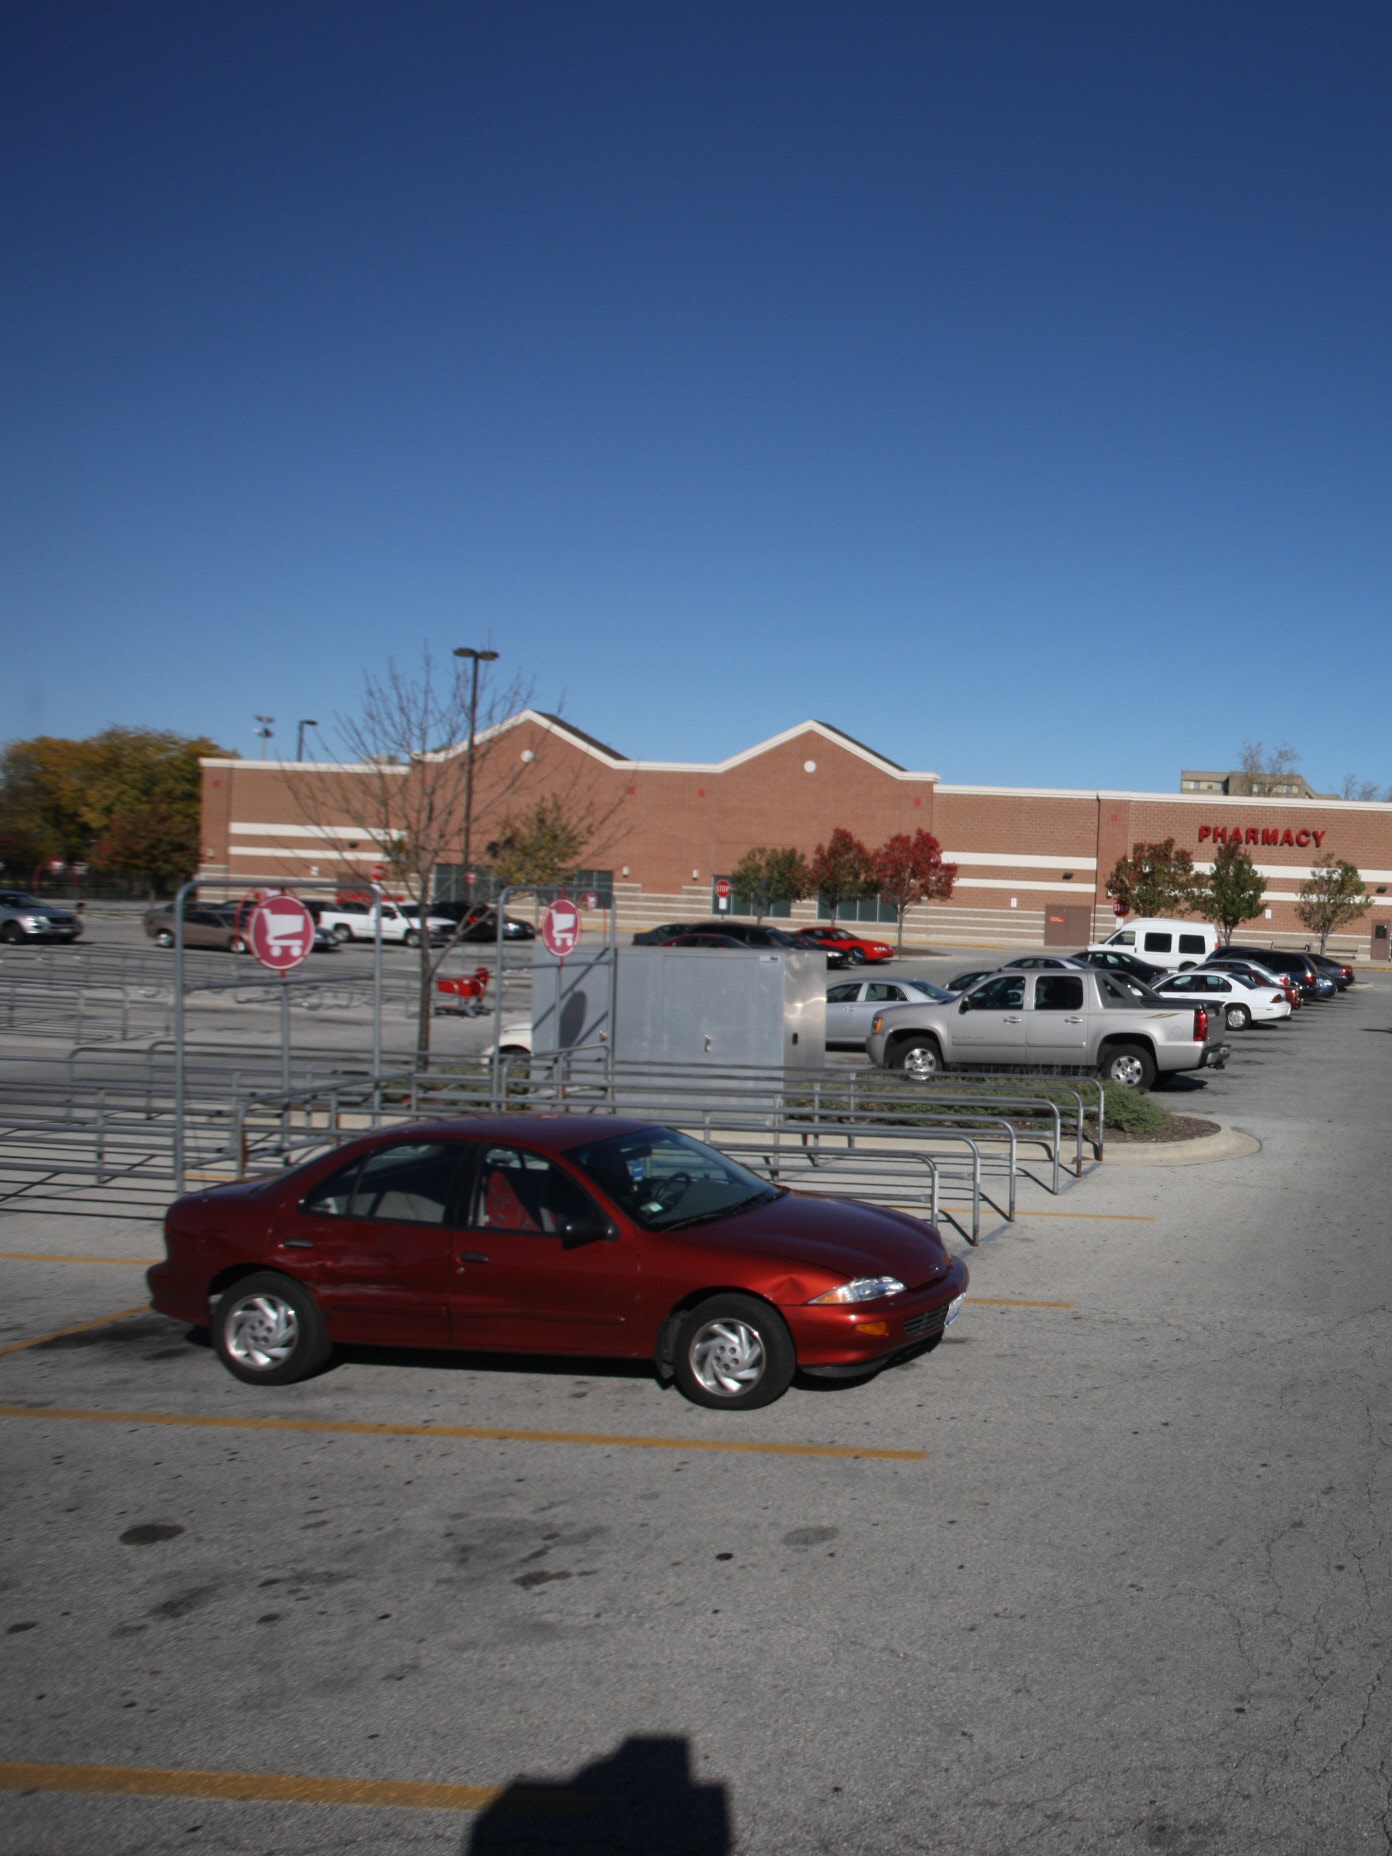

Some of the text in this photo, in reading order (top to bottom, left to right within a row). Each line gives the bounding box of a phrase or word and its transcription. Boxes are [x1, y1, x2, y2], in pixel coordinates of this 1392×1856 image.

[1198, 825, 1326, 848] PHARMACY
[715, 884, 730, 893] STOP
[1113, 903, 1129, 912] STOP
